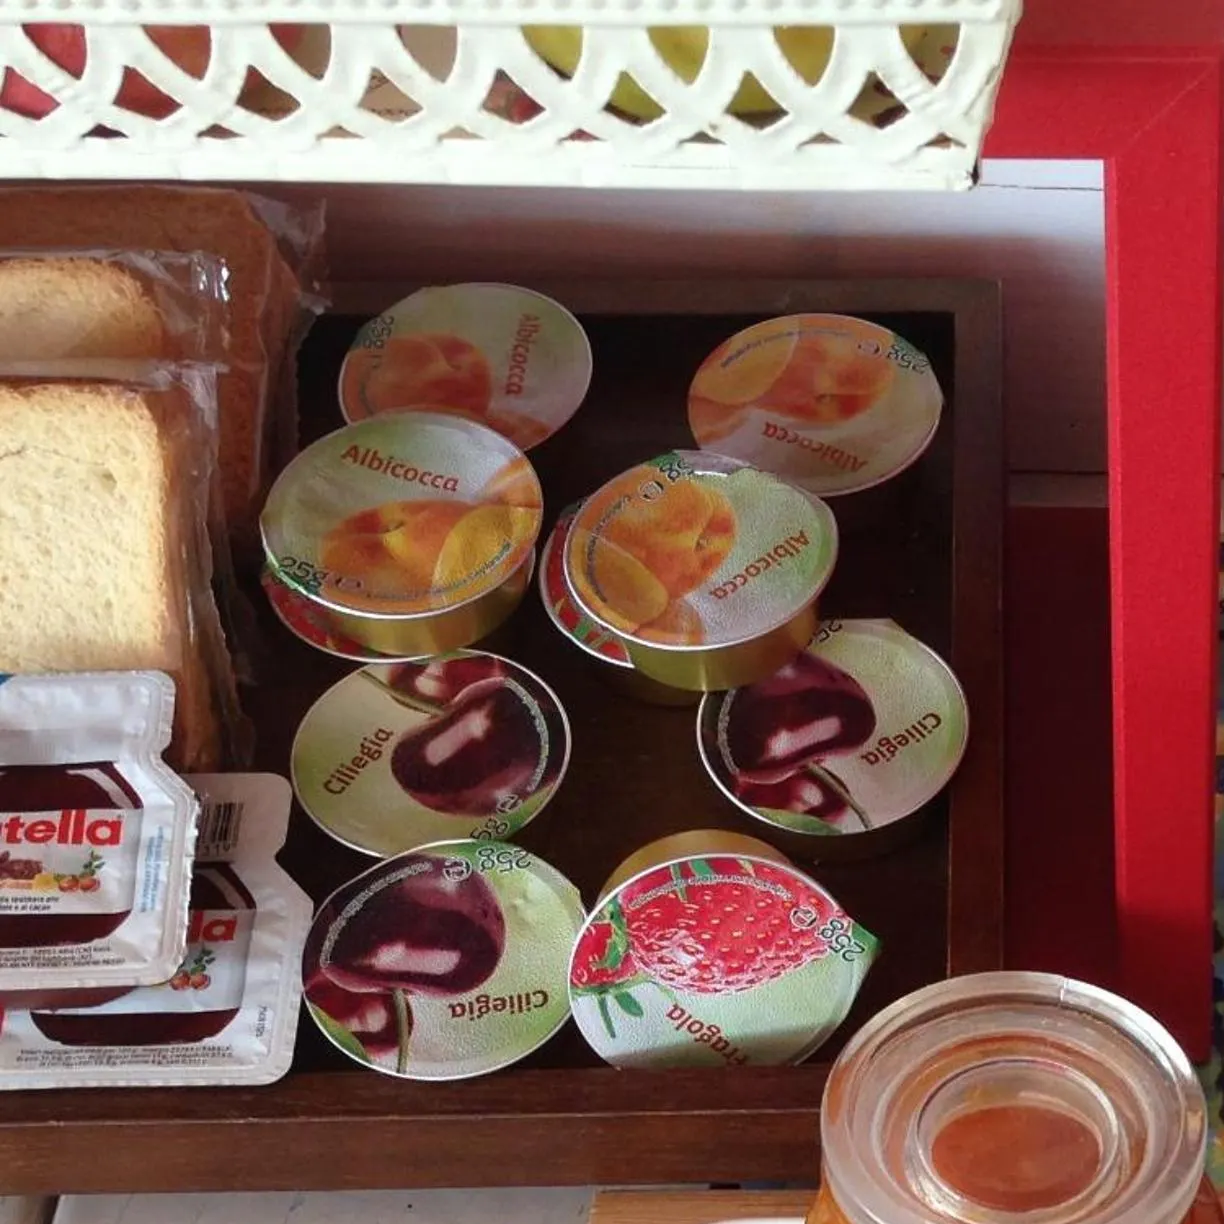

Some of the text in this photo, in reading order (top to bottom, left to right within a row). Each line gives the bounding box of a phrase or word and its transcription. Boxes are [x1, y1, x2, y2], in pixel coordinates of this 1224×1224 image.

[505, 313, 541, 395] Albicocca
[340, 444, 459, 492] Albicocca
[762, 421, 868, 473] Albicocca
[709, 529, 810, 599] Albicocca
[323, 728, 394, 795] Ciliegia
[861, 712, 942, 766] Ciliegia
[0, 809, 122, 846] tella
[469, 816, 508, 841] 5g
[478, 847, 532, 872] 25g
[818, 918, 866, 962] 25g
[448, 990, 549, 1021] Ciliegia
[666, 1003, 750, 1066] Fragola
